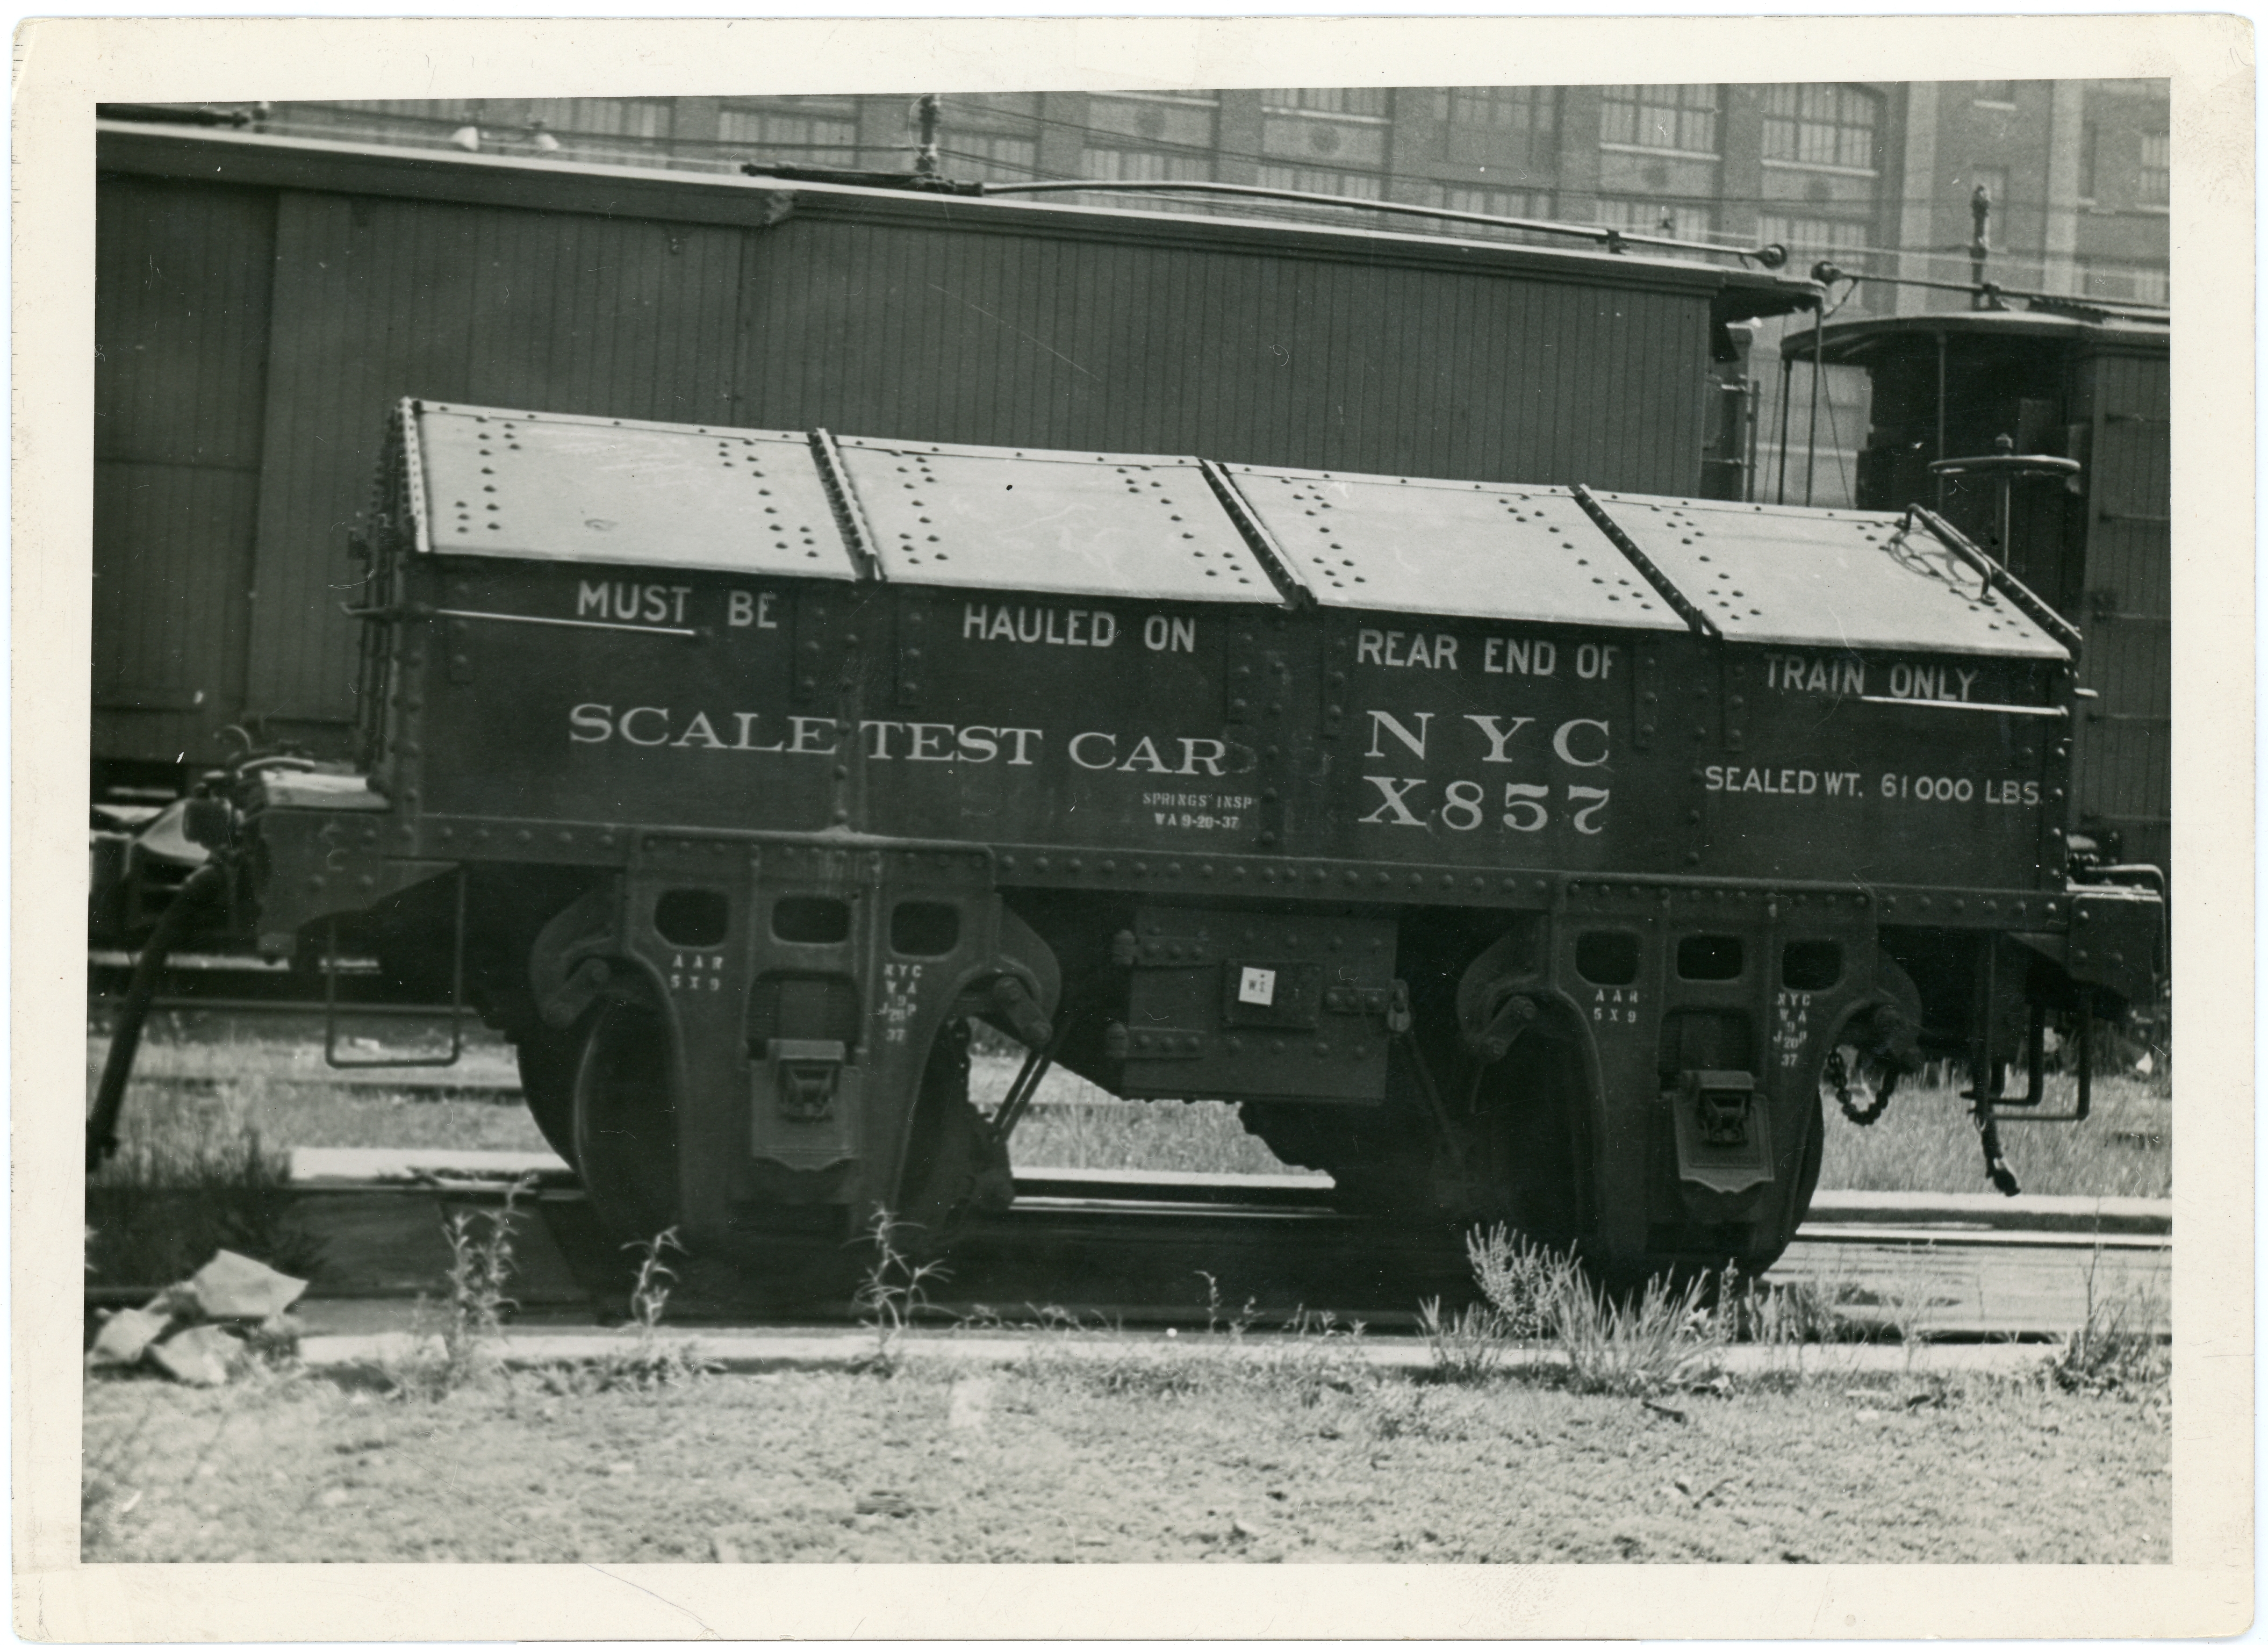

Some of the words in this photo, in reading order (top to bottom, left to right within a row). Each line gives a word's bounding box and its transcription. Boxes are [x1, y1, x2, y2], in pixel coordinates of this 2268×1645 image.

[577, 580, 691, 623] MUST
[727, 591, 778, 630] BE
[963, 605, 1116, 648] HAULED
[1144, 616, 1195, 653] ON
[1357, 629, 1458, 671] REAR
[1483, 638, 1556, 677] END
[1576, 644, 1619, 680] OF
[1763, 653, 1865, 694] TRAIN
[1890, 663, 1979, 702] ONLY
[570, 702, 838, 756] SCALE
[858, 720, 1043, 766] TEST
[1067, 731, 1226, 777] CAR
[1143, 792, 1207, 808] SPRINGS
[1217, 795, 1253, 809] INSP
[1358, 775, 1610, 835] X857
[1705, 765, 1818, 795] SEALED
[1824, 771, 1864, 798] WT.
